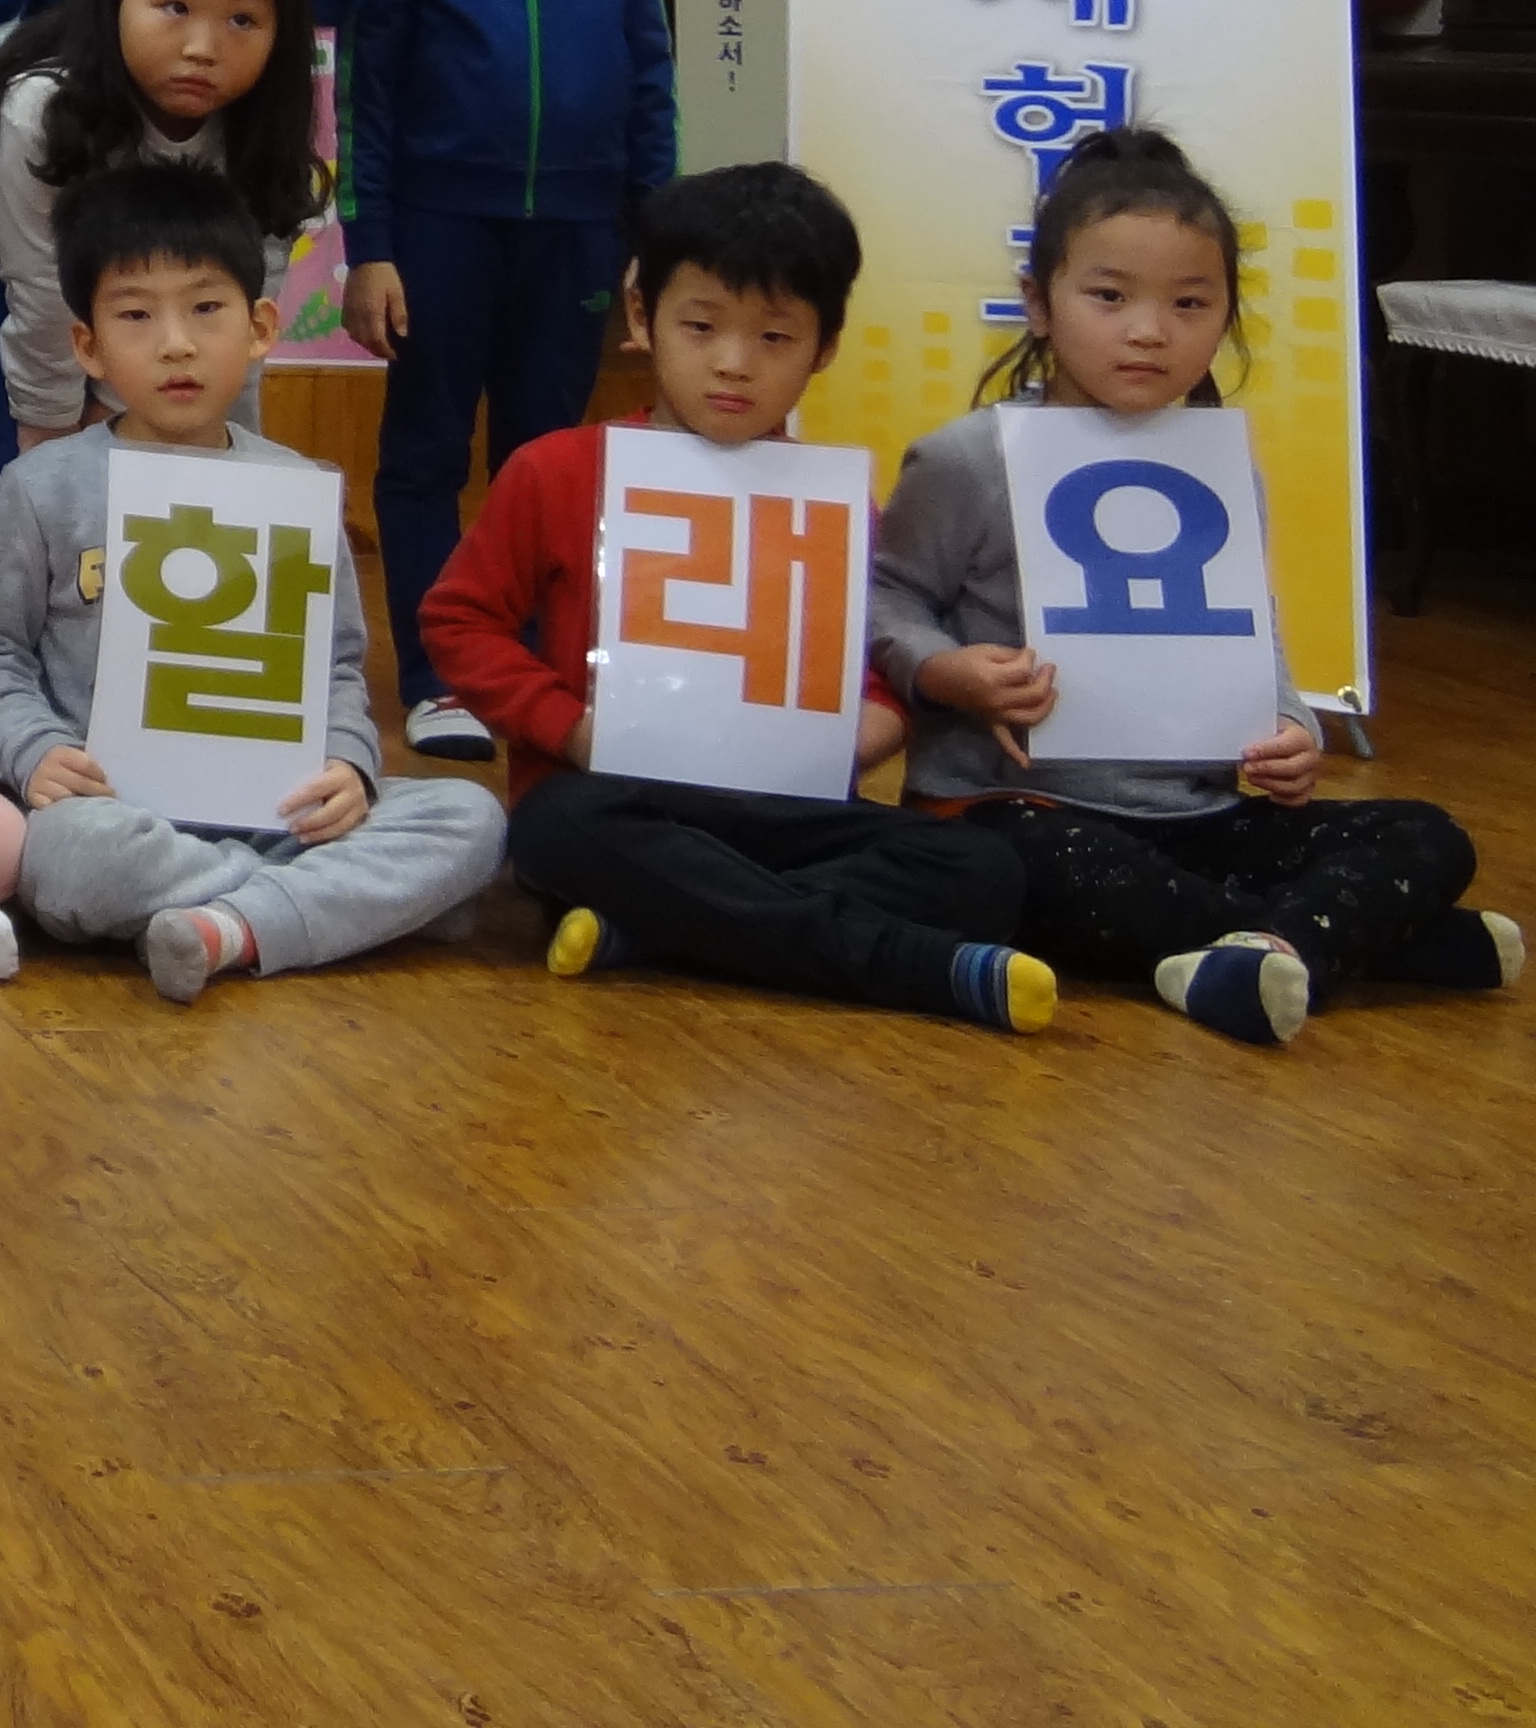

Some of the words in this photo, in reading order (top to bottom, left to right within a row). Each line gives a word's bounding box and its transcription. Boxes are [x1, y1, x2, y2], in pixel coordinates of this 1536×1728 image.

[120, 503, 331, 744] 할
[619, 485, 851, 715] 래
[1041, 458, 1256, 638] 요
